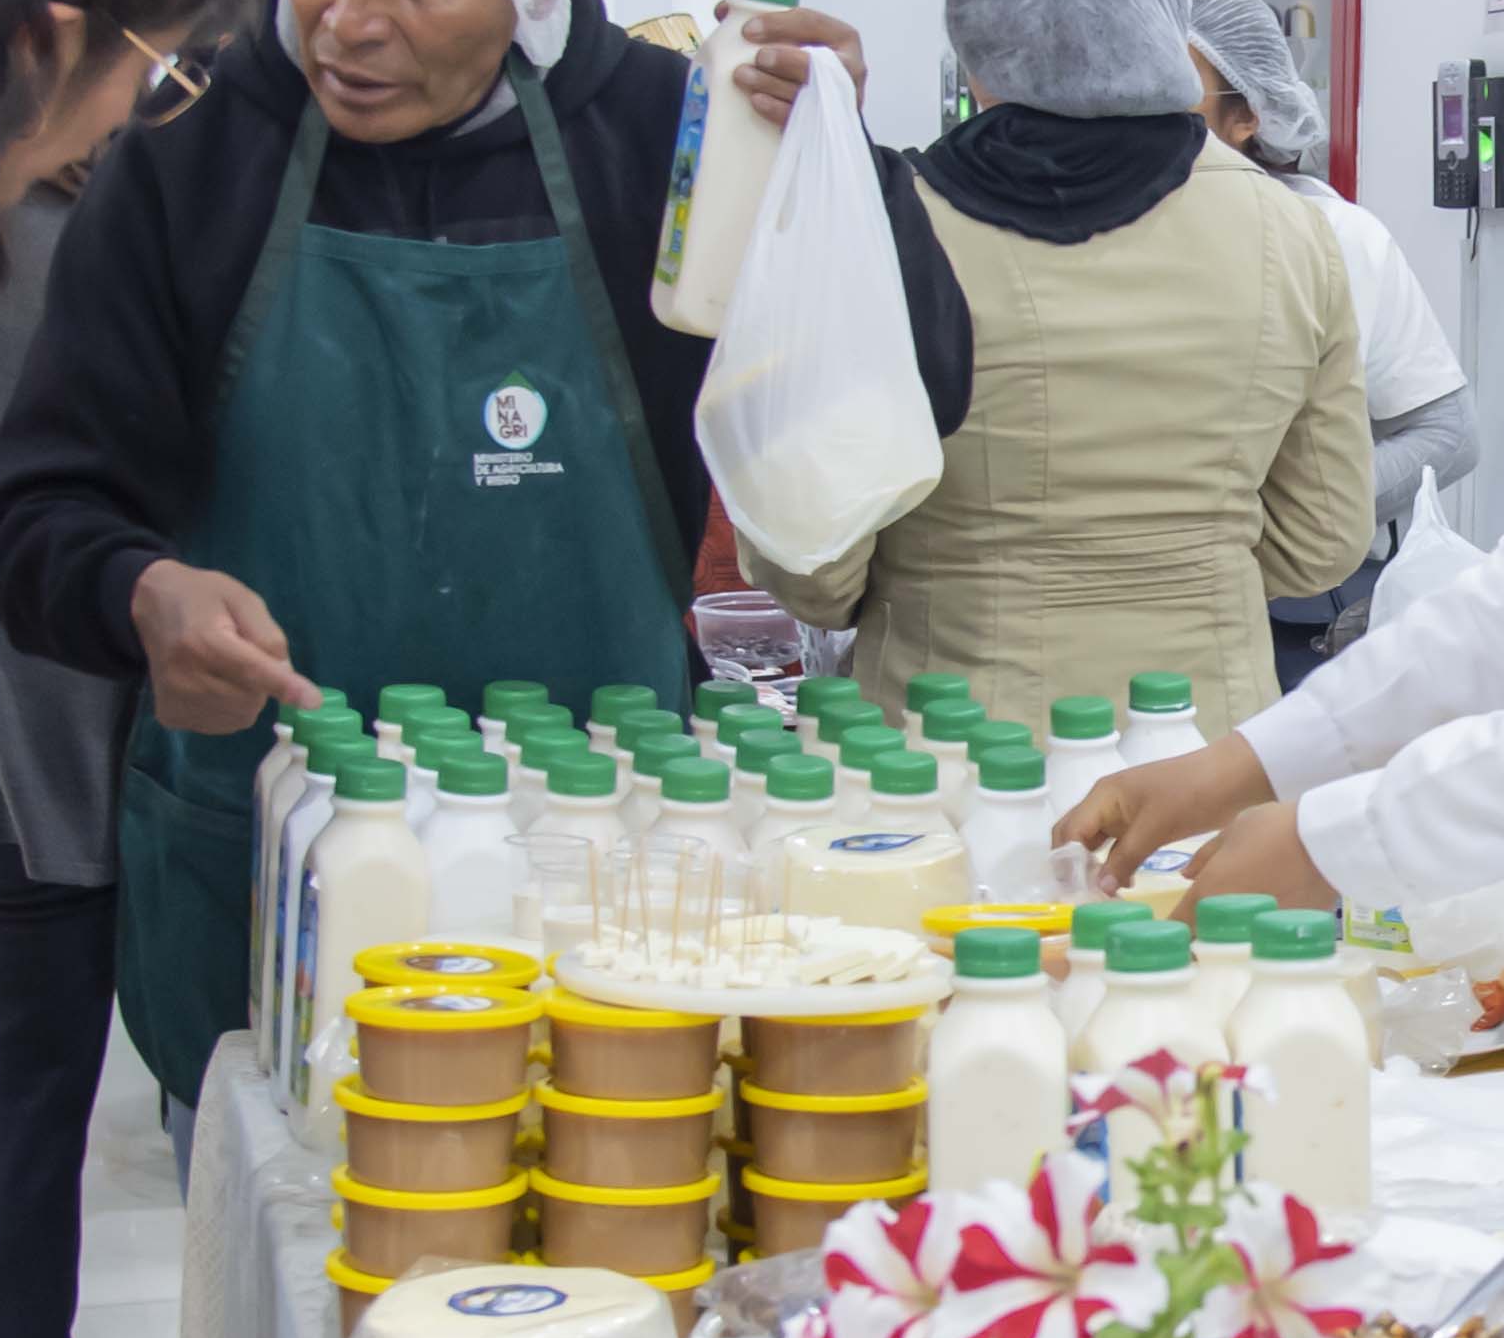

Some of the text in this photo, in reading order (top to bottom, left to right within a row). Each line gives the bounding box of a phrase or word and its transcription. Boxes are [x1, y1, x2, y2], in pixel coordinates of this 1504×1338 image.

[496, 395, 516, 410] MI
[497, 410, 523, 425] NA
[499, 424, 528, 439] GRI
